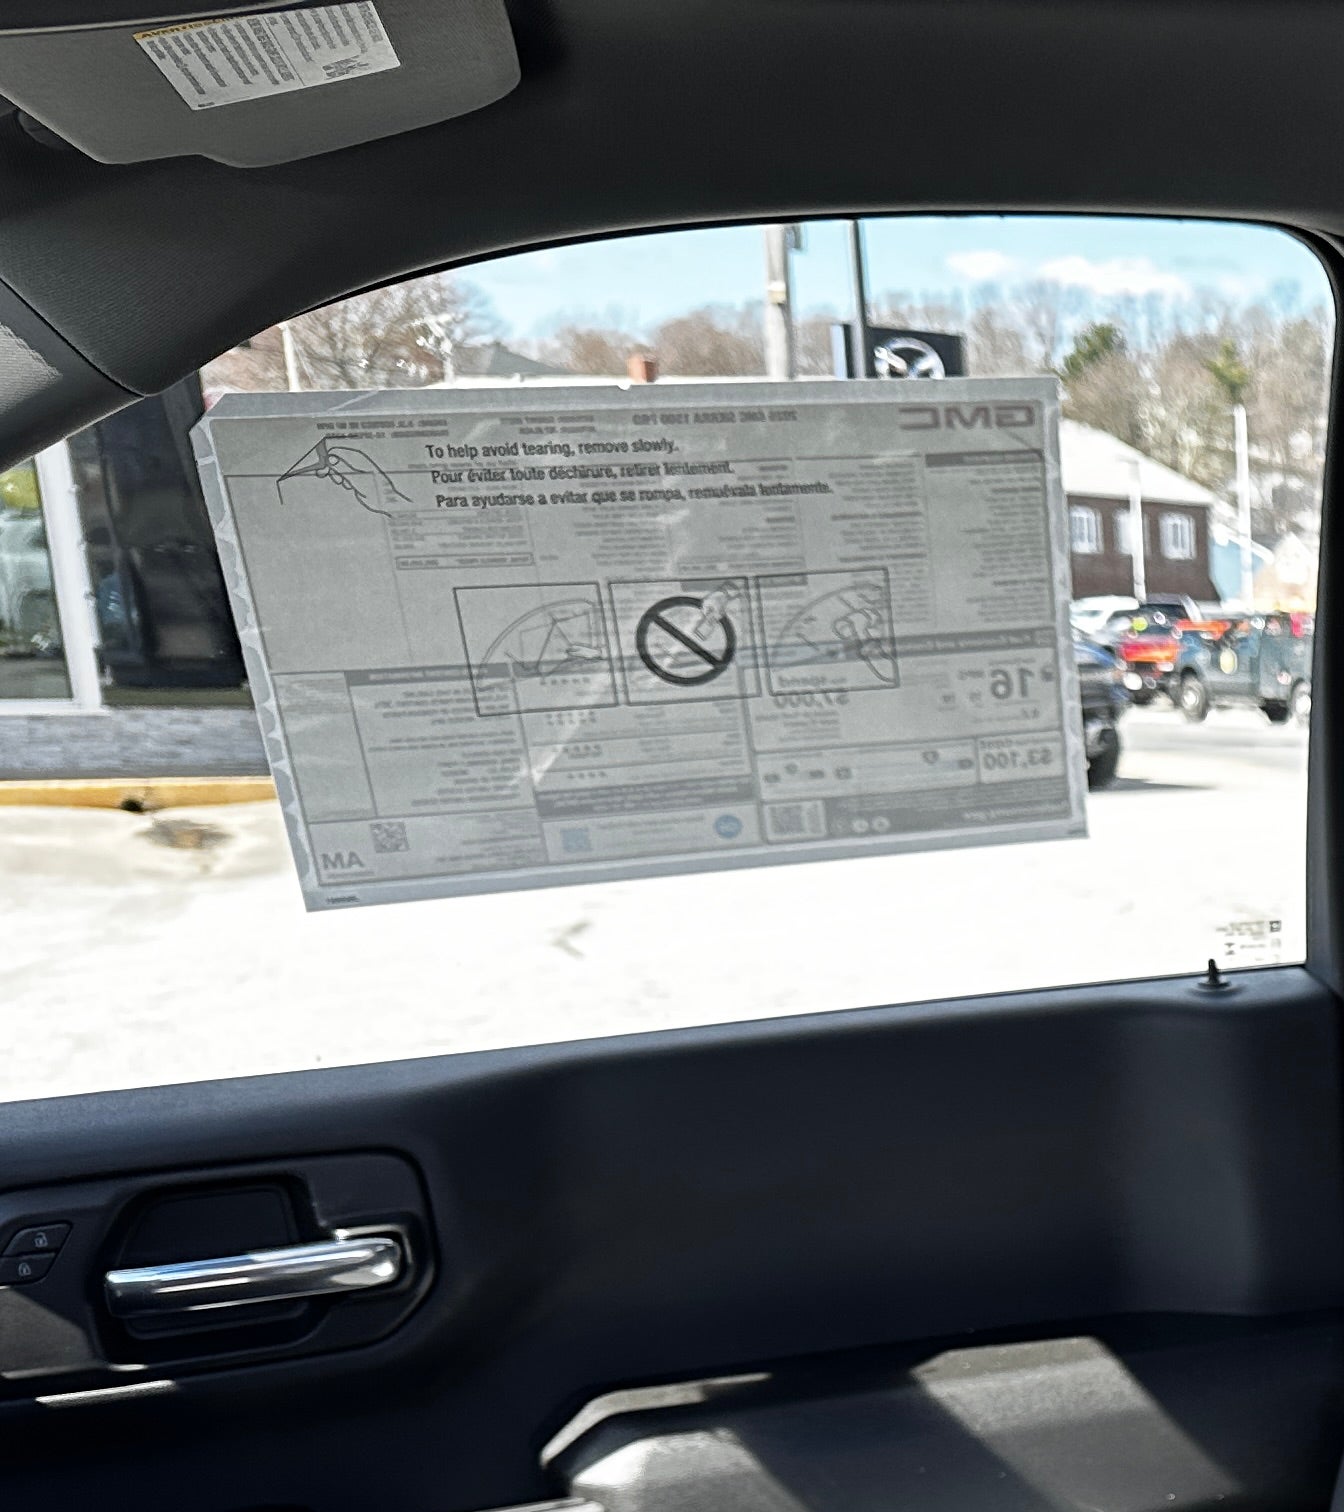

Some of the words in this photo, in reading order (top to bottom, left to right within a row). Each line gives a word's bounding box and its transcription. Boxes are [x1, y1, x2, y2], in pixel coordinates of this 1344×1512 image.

[425, 444, 444, 458] To
[446, 444, 478, 460] help
[482, 441, 518, 456] avoid
[521, 441, 575, 457] tearing,
[578, 441, 629, 454] remove
[630, 438, 679, 454] slowly.
[431, 470, 463, 483] Pour
[467, 468, 505, 482] éviter
[509, 468, 545, 481] toute
[548, 466, 617, 480] déchirure,
[620, 464, 660, 477] retirer
[436, 494, 469, 508] Para
[472, 493, 535, 509] ayudarse
[538, 494, 548, 505] a
[550, 490, 588, 504] evitar
[591, 491, 616, 504] que
[620, 490, 635, 501] se
[639, 489, 686, 502] rompa,
